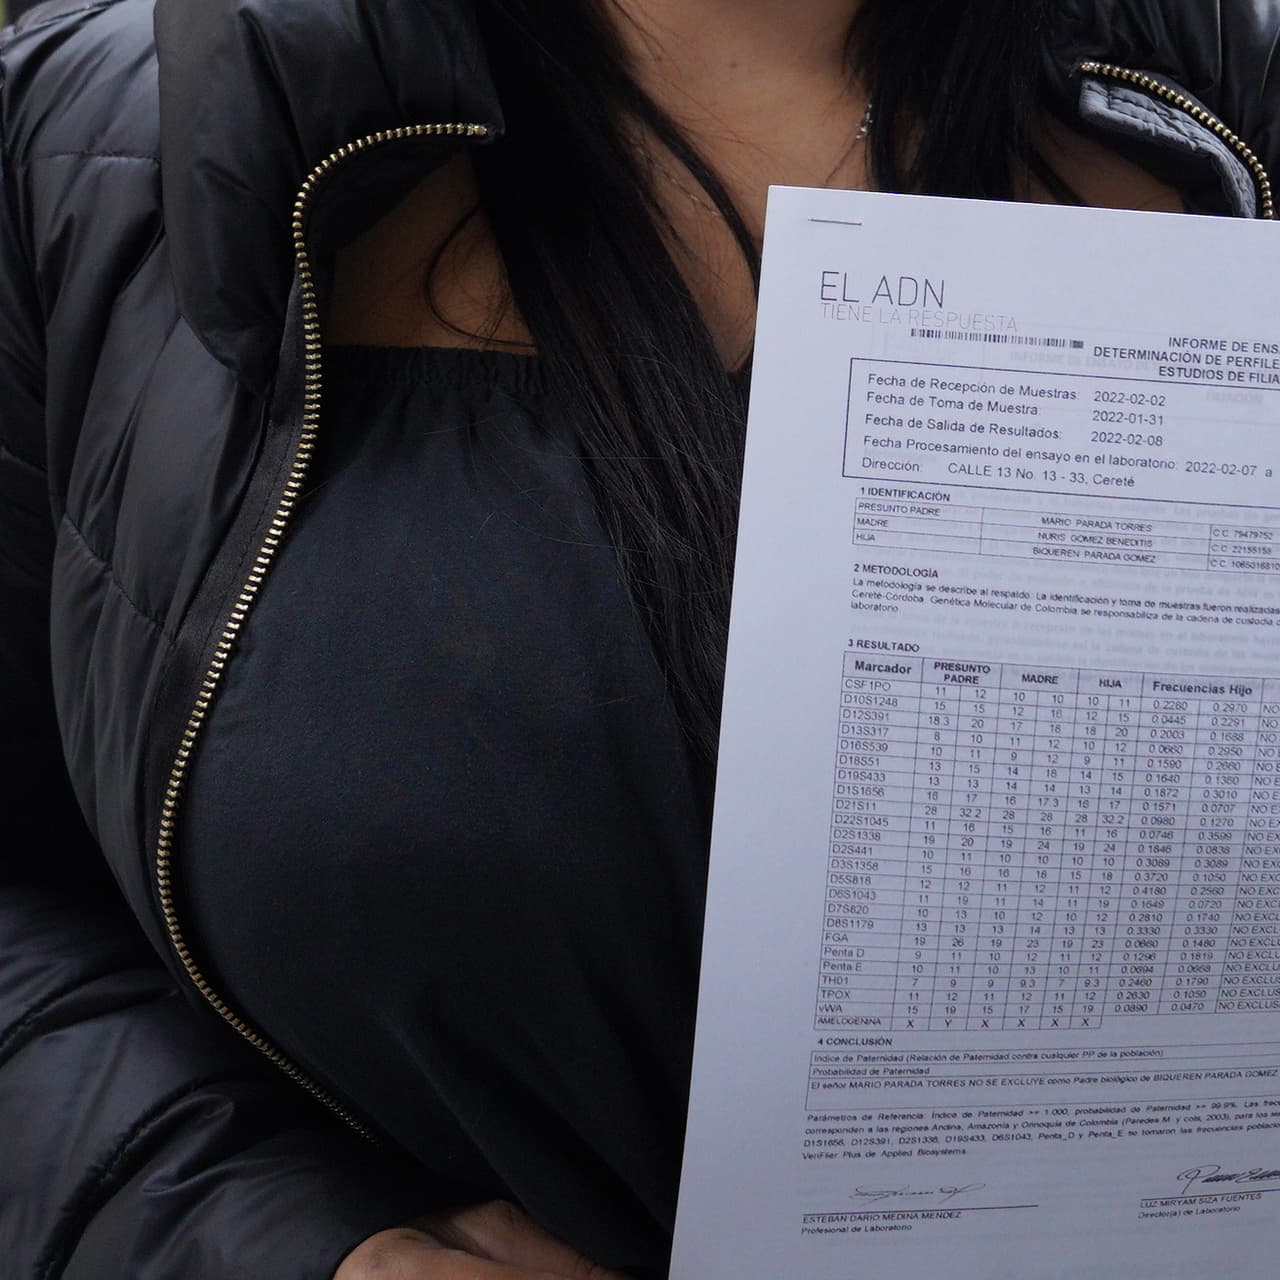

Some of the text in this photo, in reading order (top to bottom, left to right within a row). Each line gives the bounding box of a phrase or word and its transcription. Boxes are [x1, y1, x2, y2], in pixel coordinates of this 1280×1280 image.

[820, 270, 945, 309] EL ADN
[820, 302, 1018, 332] TIENE LA RESPUESTA
[1168, 336, 1227, 351] INFORME
[1231, 341, 1248, 352] DE
[1093, 346, 1201, 364] DETERMINACIÓN
[1205, 354, 1222, 366] DE
[1158, 365, 1224, 382] ESTUDIOS
[1228, 371, 1245, 383] DE
[868, 373, 1166, 407] Fecha de Recepción de Muestras: 2022-02-02
[866, 391, 905, 406] Fecha
[909, 395, 925, 407] de
[928, 396, 964, 410] Toma
[968, 400, 983, 411] de
[1092, 410, 1164, 426] 2022-01-31
[865, 413, 1164, 447] Fecha de Salida de Resultados: 2022-02-08
[863, 435, 902, 450] Fecha
[906, 438, 999, 457] Procesamiento
[1002, 445, 1023, 459] del
[1026, 450, 1071, 464] ensayo
[1075, 453, 1090, 463] en
[1094, 452, 1105, 464] el
[1185, 460, 1257, 476] 2022-02-07
[1265, 469, 1273, 478] a
[948, 462, 992, 477] CALLE
[997, 467, 1011, 479] 13
[1043, 470, 1057, 482] 13
[1093, 474, 1135, 488] Cereté
[868, 487, 951, 502] IDENTIFICACIÓN
[858, 502, 940, 517] PRESUNTO PADRE
[856, 518, 889, 528] MADRE
[1042, 517, 1152, 532] MARIO PARADA TORRES
[856, 533, 876, 542] HIJA
[1038, 532, 1066, 541] NURIS
[1084, 550, 1121, 561] PARADA
[853, 564, 938, 579] 2 METODOLOGÍA
[852, 579, 863, 587] La
[866, 580, 922, 593] metodología
[938, 585, 977, 595] describe
[980, 587, 988, 595] al
[1035, 591, 1046, 600] La
[1050, 592, 1108, 605] identificación
[1120, 598, 1140, 606] toma
[1144, 599, 1154, 607] de
[1158, 601, 1201, 611] muestras
[1203, 602, 1231, 612] fueron
[974, 599, 1018, 610] Molecular
[1021, 602, 1031, 610] de
[1035, 603, 1077, 614] Colombia
[848, 639, 920, 653] 3 RESULTADO
[855, 661, 912, 675] Marcador
[934, 661, 991, 674] PRESUNTO
[845, 678, 891, 691] CSF1PO
[944, 674, 979, 685] PADRE
[1021, 674, 1059, 685] MADRE
[1099, 678, 1122, 689] HIJA
[975, 690, 987, 700] 12
[1153, 681, 1252, 698] Frecuencias Hijo
[1263, 705, 1279, 715] NO
[825, 932, 849, 943] FGA
[824, 947, 865, 958] Penta D
[826, 1037, 893, 1047] CONCLUSIÓN
[884, 1080, 924, 1089] PARADA
[927, 1079, 966, 1088] TORRES
[968, 1079, 983, 1088] NO
[985, 1078, 998, 1087] SE
[1000, 1076, 1045, 1087] EXCLUYE
